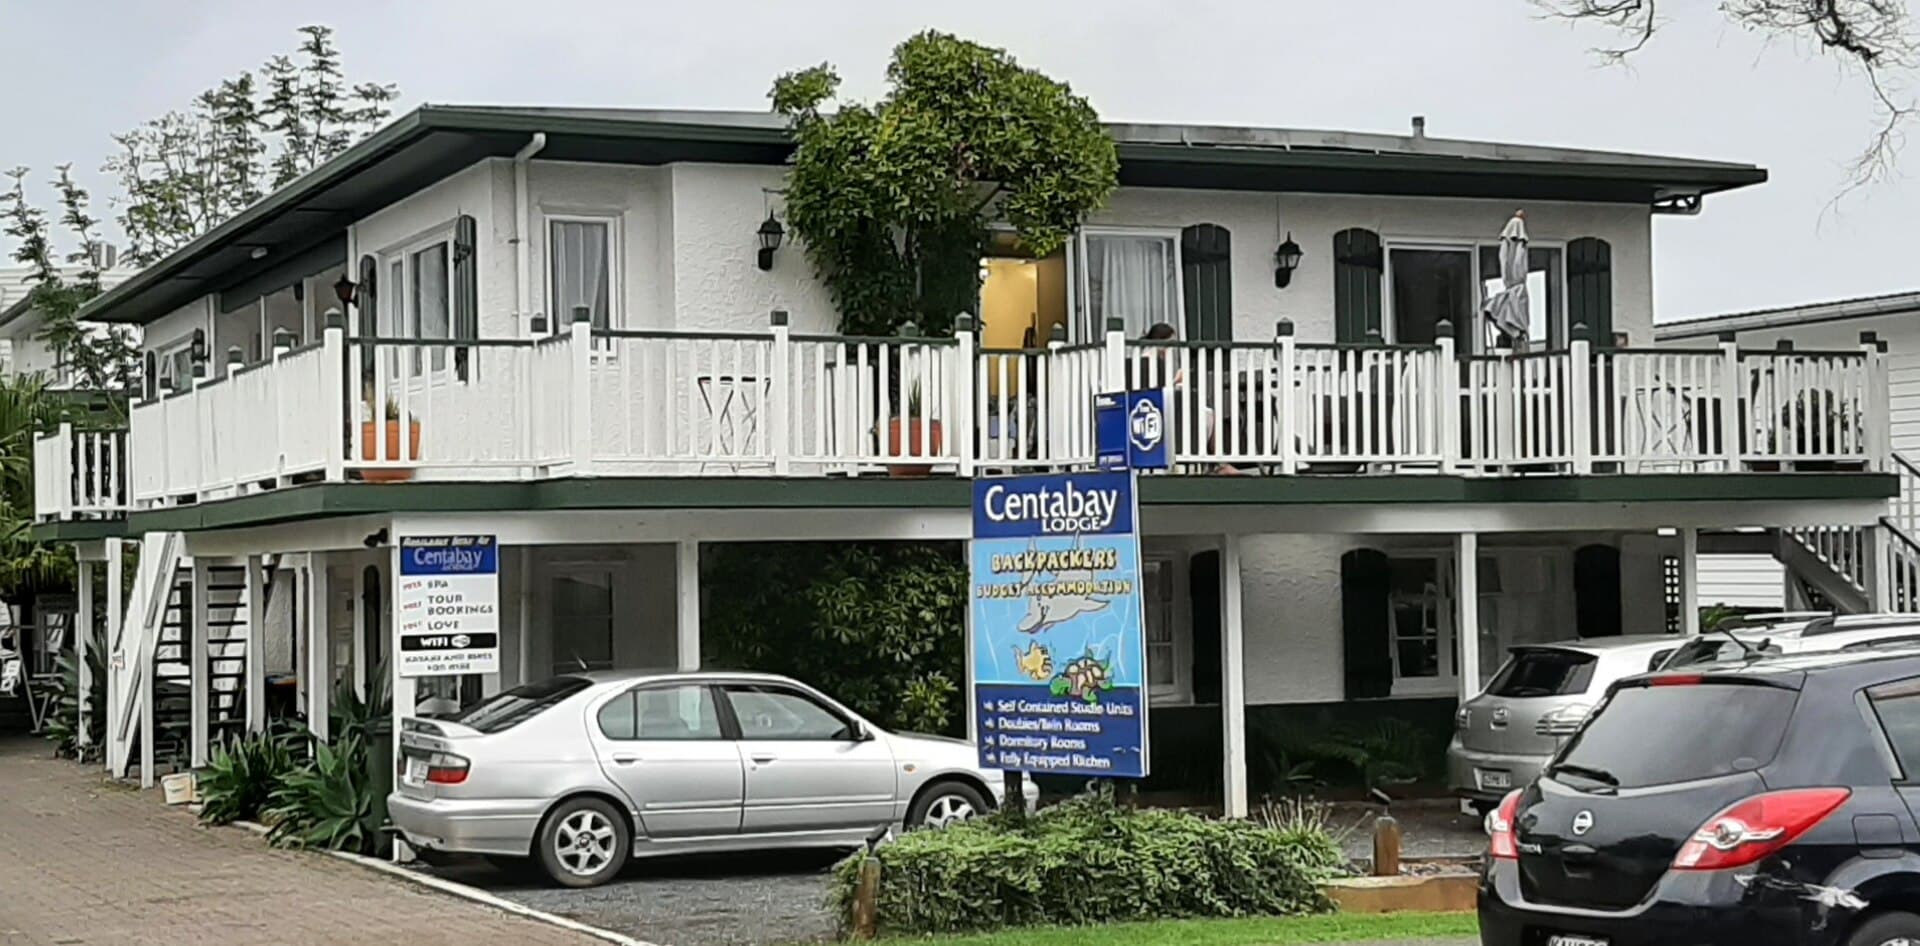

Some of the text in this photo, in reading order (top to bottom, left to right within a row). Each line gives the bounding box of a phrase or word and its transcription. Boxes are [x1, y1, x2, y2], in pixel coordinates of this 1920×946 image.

[985, 480, 1117, 526] Centabay
[1042, 516, 1101, 532] LODGE
[413, 547, 482, 570] Centabay
[991, 549, 1117, 573] BACKPACKERS
[427, 580, 449, 589] SPA
[976, 581, 1131, 599] BUDGET ACCOMMODATION
[427, 594, 463, 604] TOUR
[427, 605, 494, 616] BOOKINGS
[427, 621, 460, 631] LOVE
[997, 700, 1134, 716] Self Contained Studio Units
[1064, 720, 1101, 733] Rooms
[999, 735, 1087, 750] Dormitory Rooms
[1024, 753, 1070, 769] Equipped
[1072, 755, 1111, 769] Kitchen
